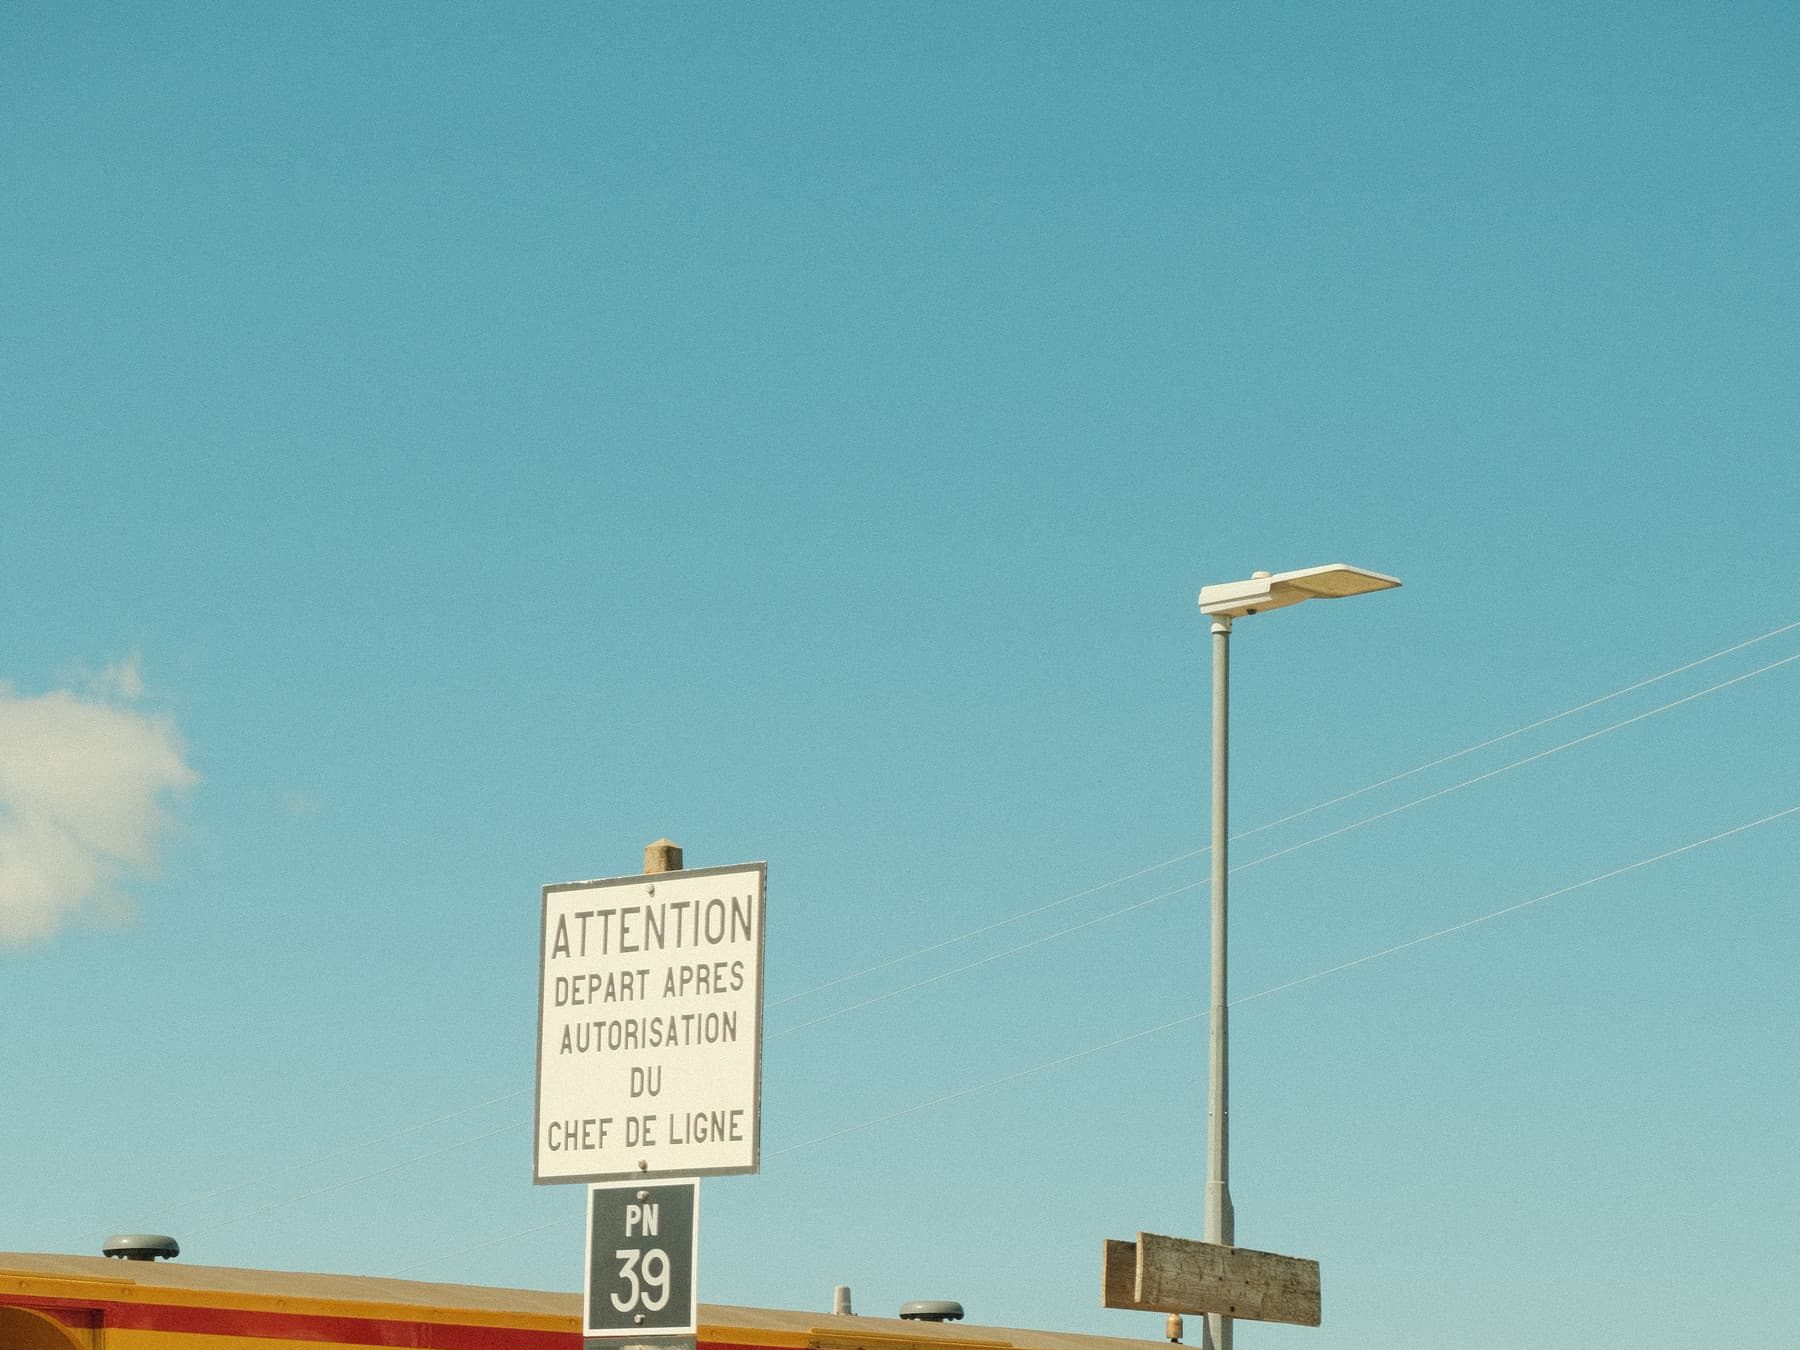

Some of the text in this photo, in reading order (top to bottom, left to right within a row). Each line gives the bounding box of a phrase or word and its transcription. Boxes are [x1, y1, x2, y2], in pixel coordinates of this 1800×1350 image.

[551, 895, 753, 959] ATTENTION
[554, 960, 744, 1007] DEPART APRES
[560, 1011, 737, 1055] AUTORISATION
[630, 1065, 662, 1098] DU
[548, 1109, 744, 1151] CHEF DE LIGNE
[625, 1203, 660, 1237] PN
[610, 1248, 671, 1312] 39
